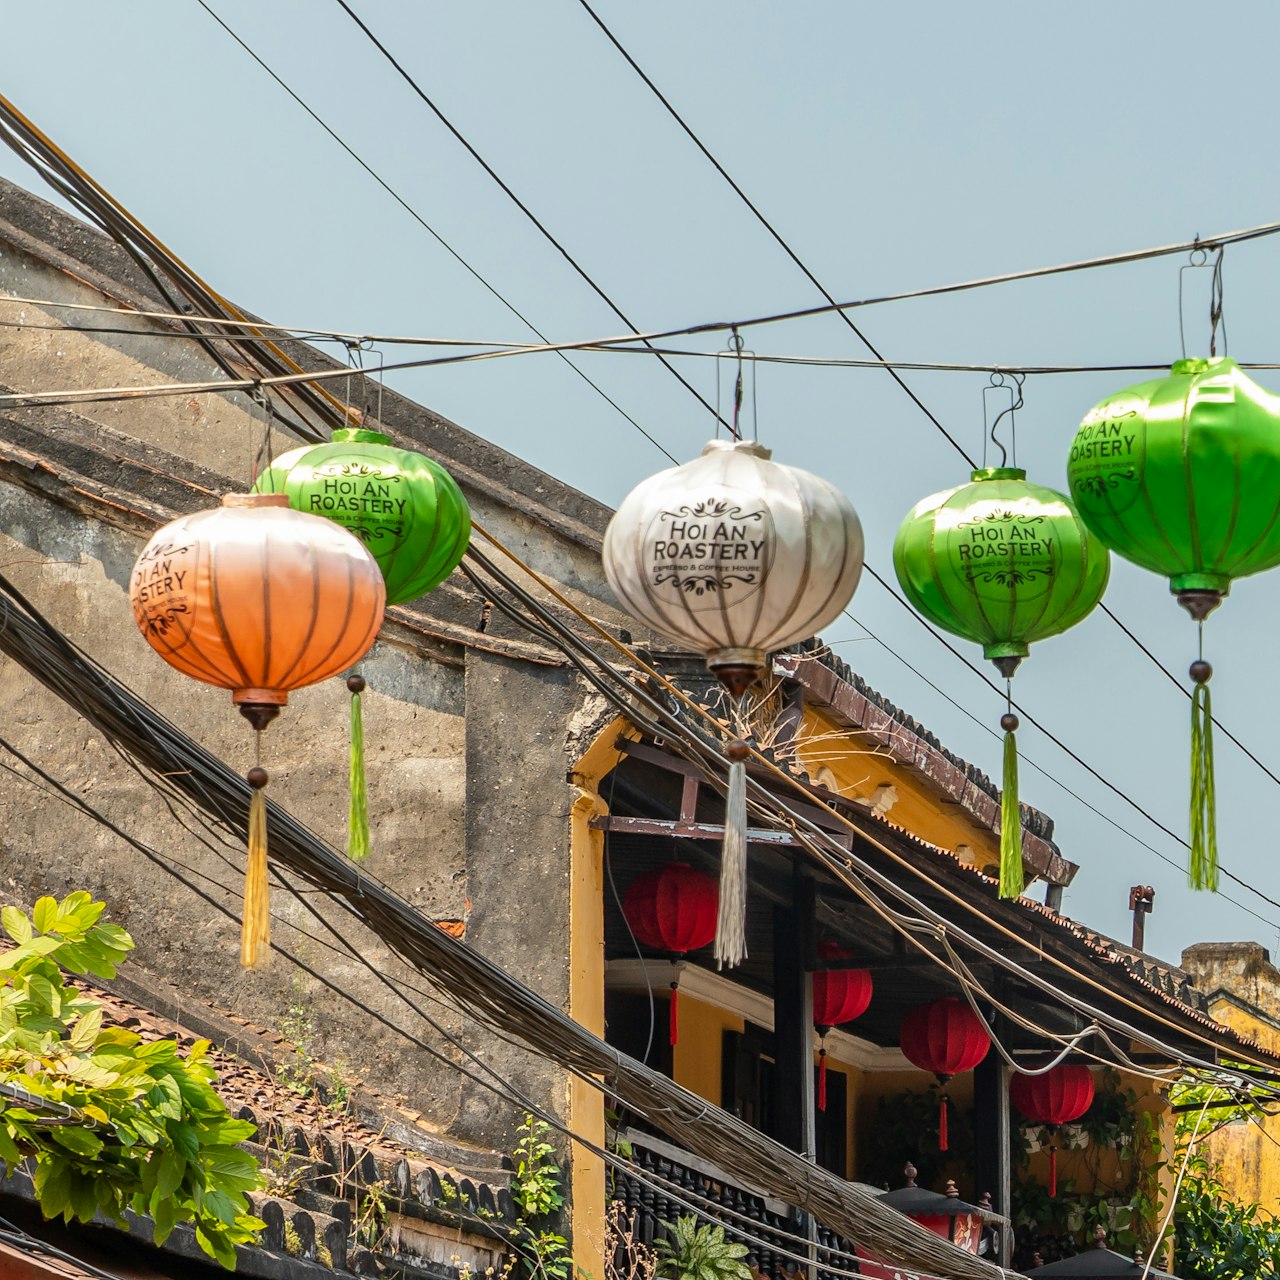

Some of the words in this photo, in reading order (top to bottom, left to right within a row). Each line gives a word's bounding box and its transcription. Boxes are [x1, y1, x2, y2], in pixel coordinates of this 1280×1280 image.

[1096, 420, 1123, 438] AN
[1071, 434, 1136, 462] OASTERY
[324, 479, 357, 495] HOI
[363, 481, 391, 497] AN
[310, 494, 407, 515] ROASTERY
[670, 521, 707, 540] HOI
[713, 522, 747, 541] AN
[971, 527, 1004, 543] HOI
[1010, 525, 1036, 541] AN
[654, 540, 765, 561] ROASTERY
[958, 537, 1053, 561] ROASTERY
[150, 559, 172, 581] AN
[698, 564, 731, 573] COFFEE
[732, 565, 761, 573] HOUSE
